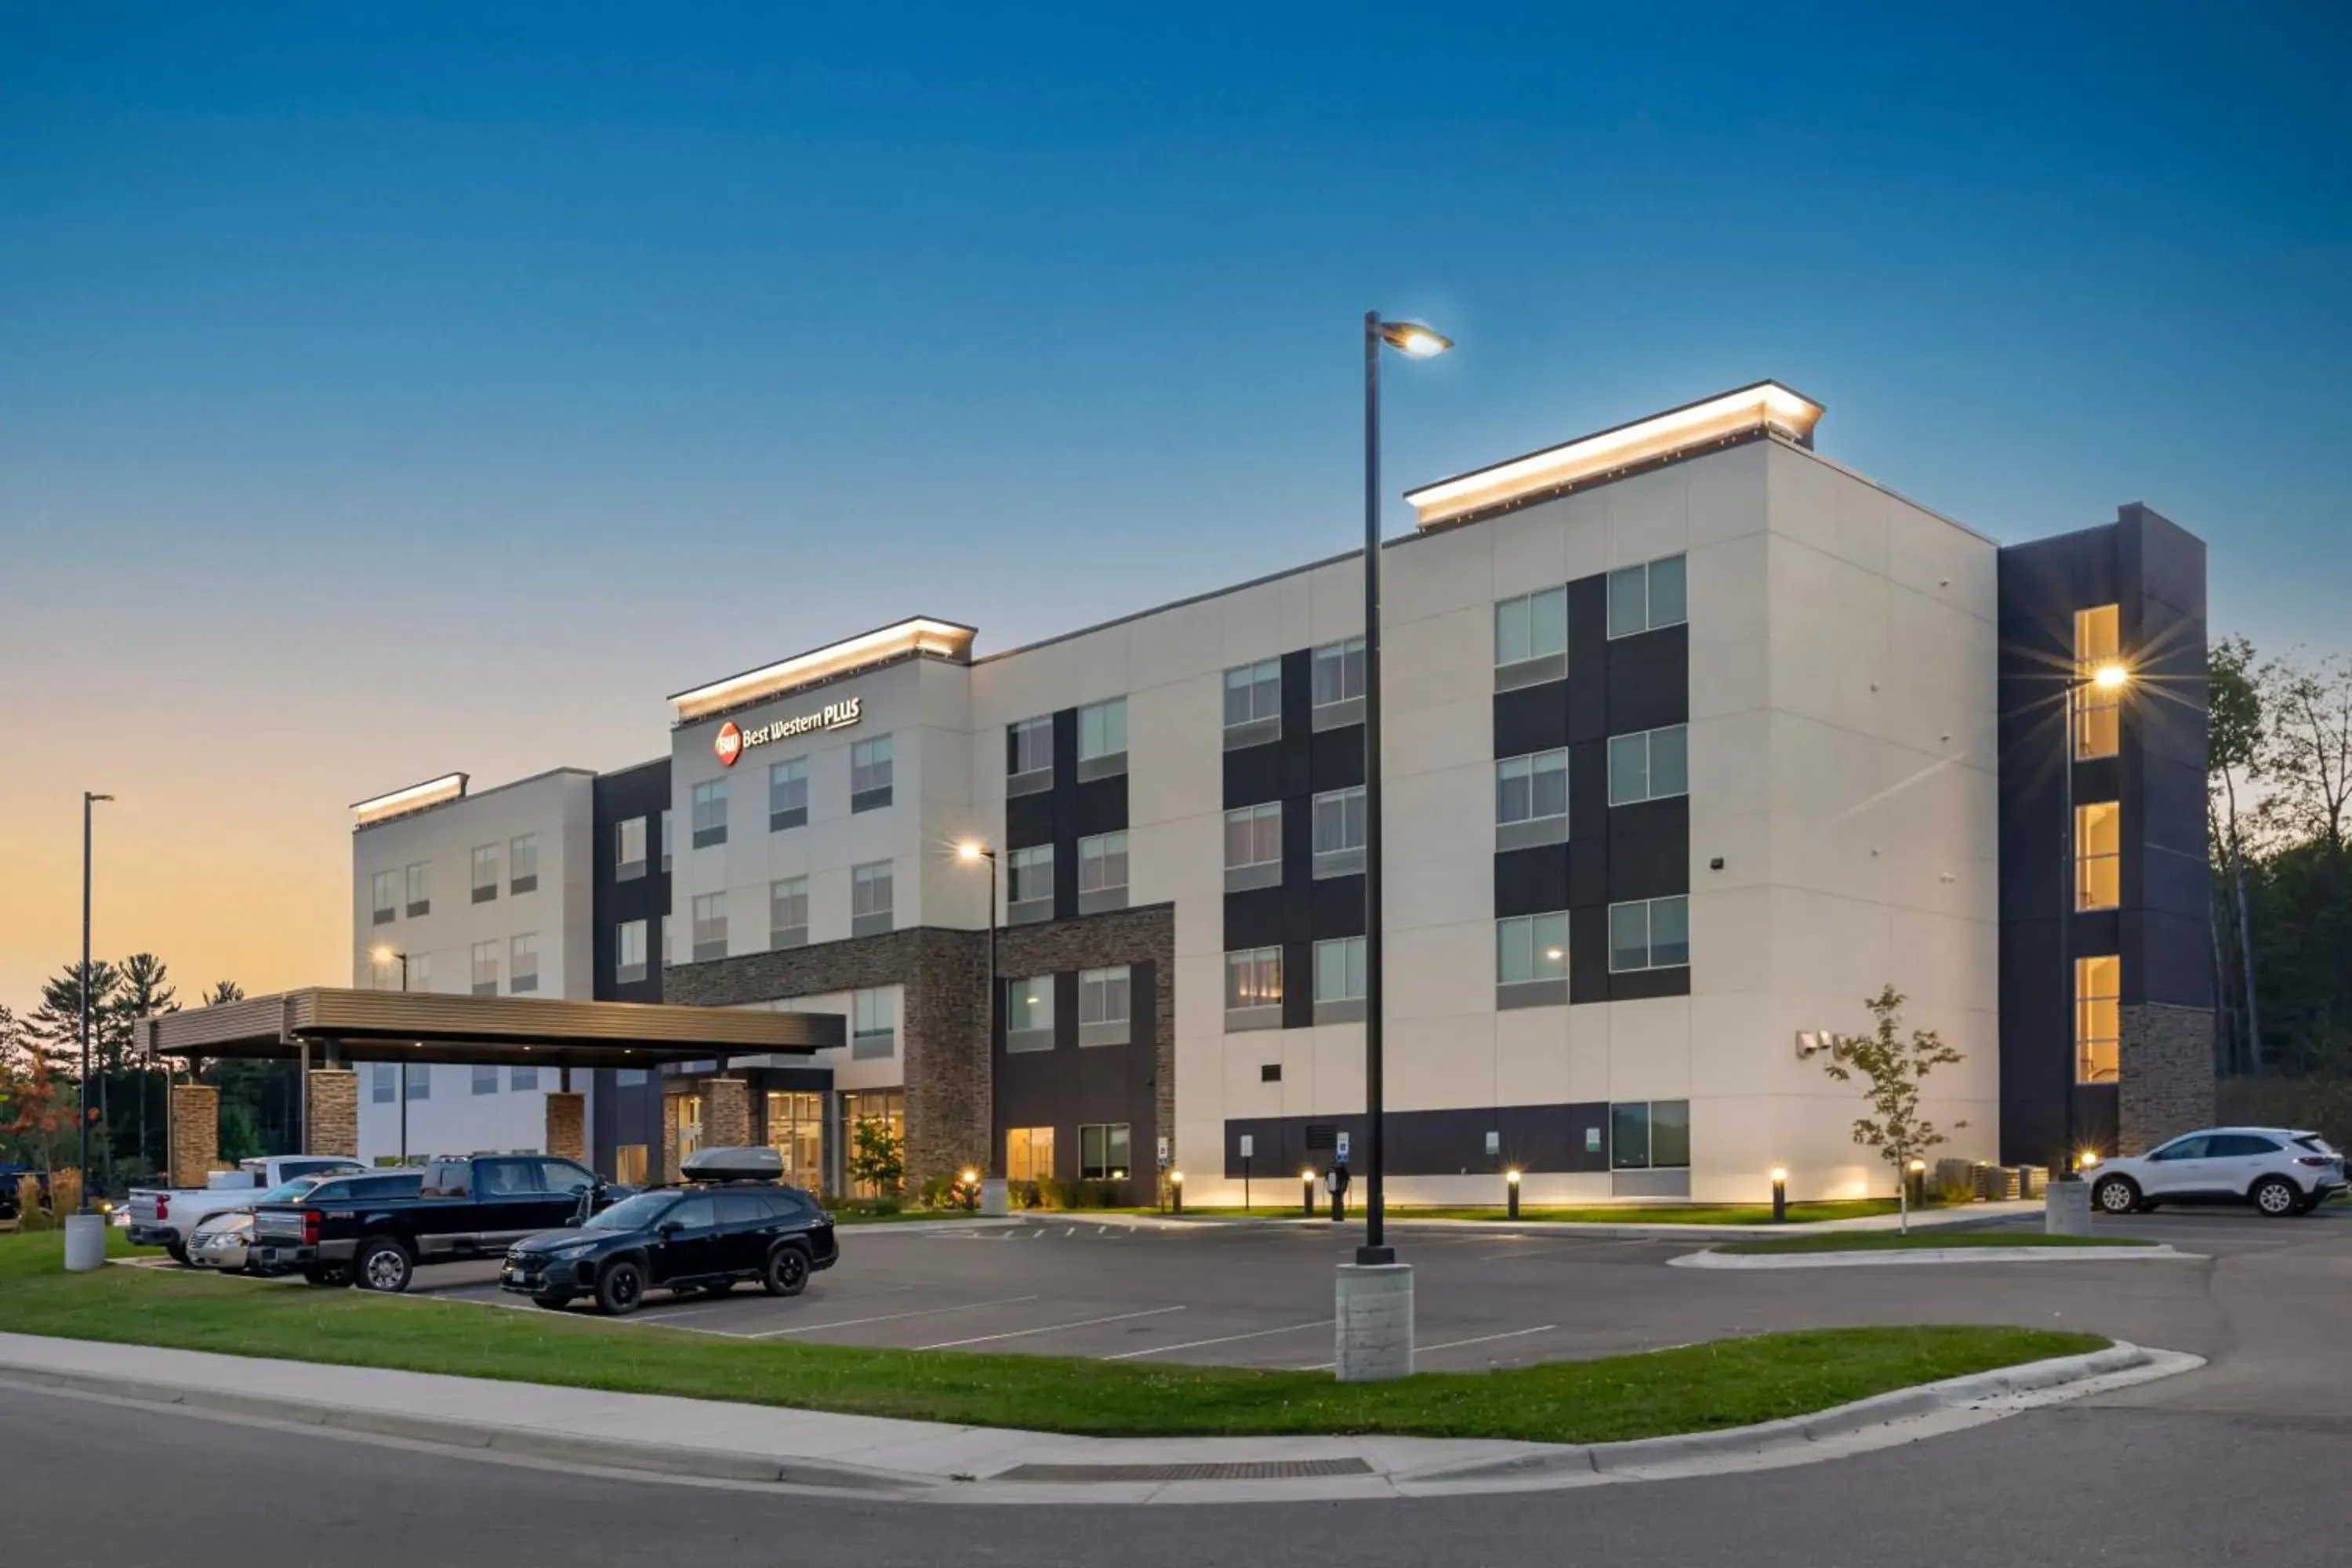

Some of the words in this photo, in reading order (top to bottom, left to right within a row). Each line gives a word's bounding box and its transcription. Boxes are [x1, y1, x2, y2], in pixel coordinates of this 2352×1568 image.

[742, 726, 769, 748] Best
[770, 712, 822, 740] Western
[824, 697, 860, 725] PLUS
